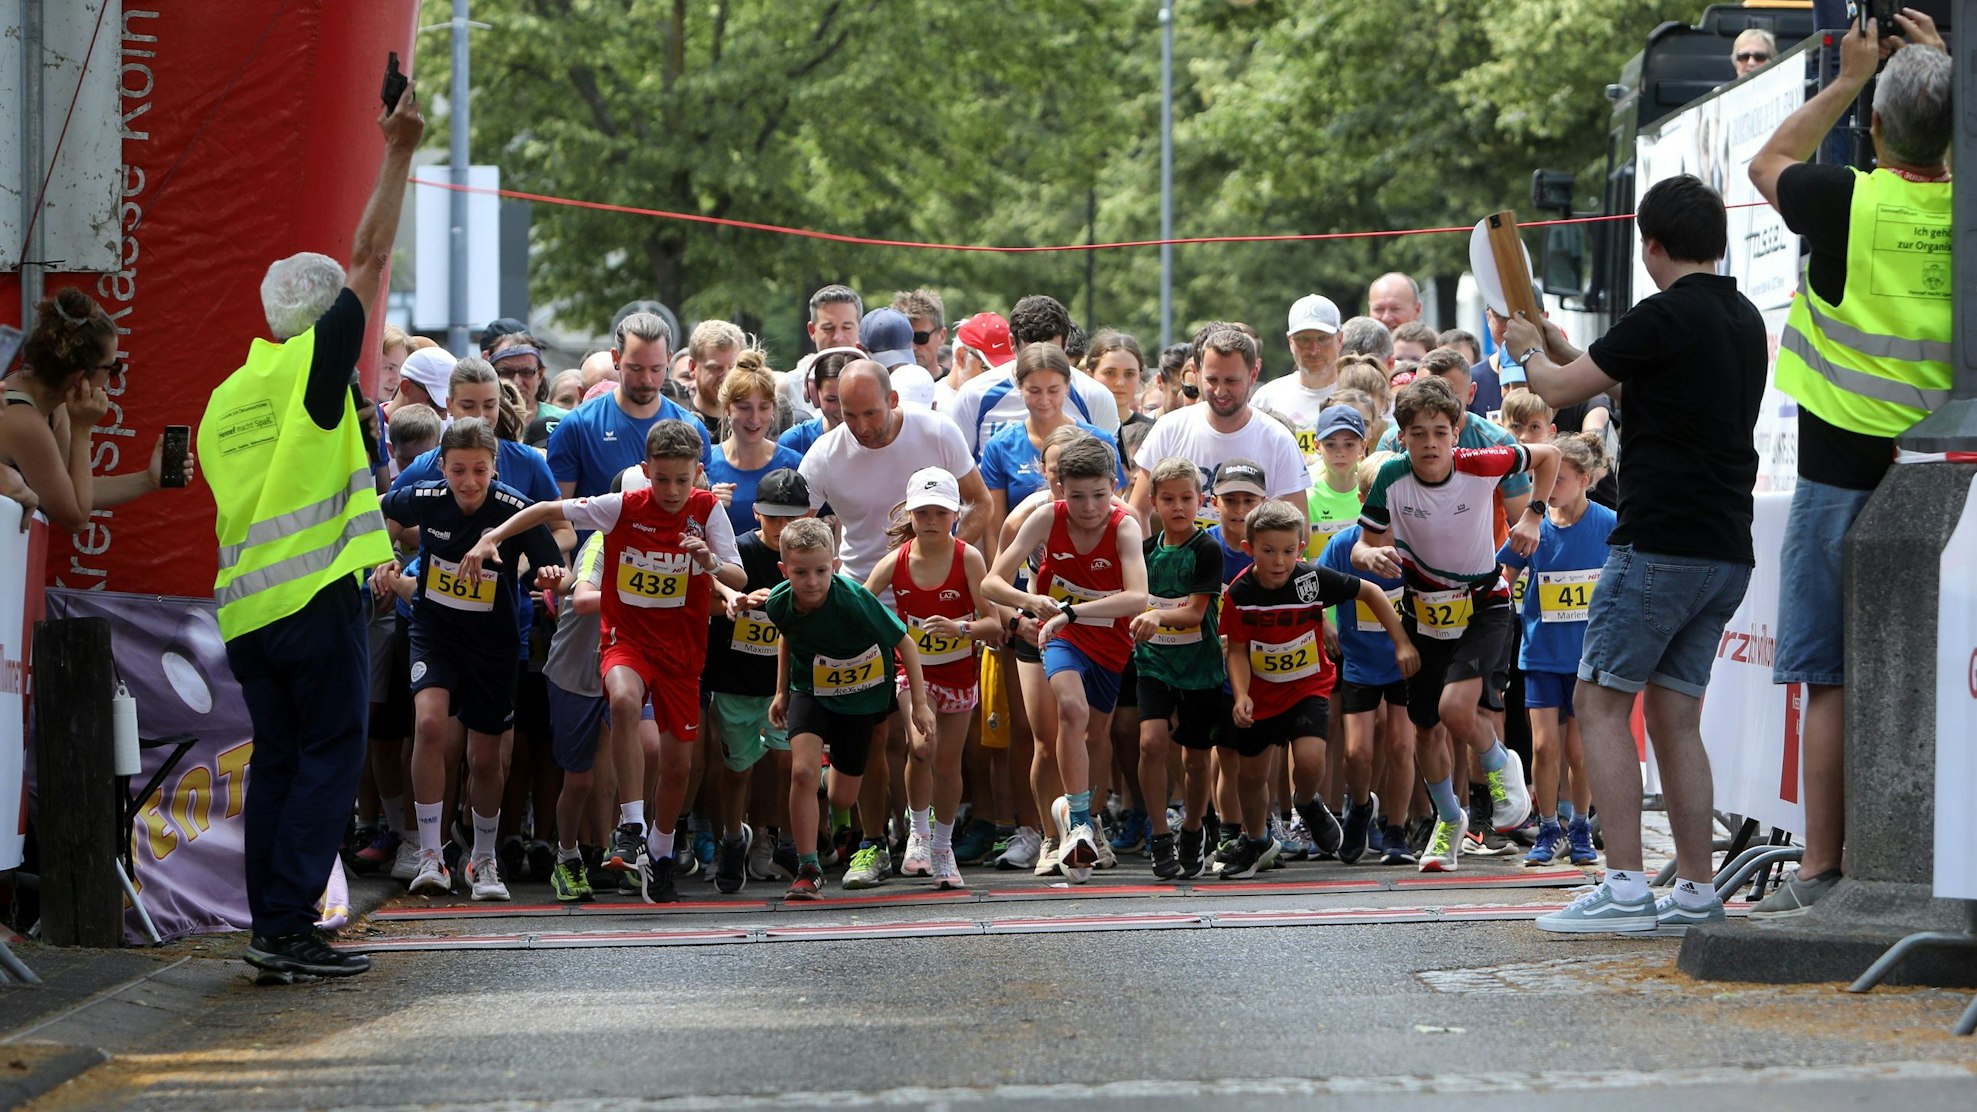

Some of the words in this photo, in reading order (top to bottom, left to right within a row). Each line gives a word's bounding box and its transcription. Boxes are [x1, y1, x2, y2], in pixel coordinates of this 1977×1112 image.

[1914, 227, 1928, 236] Ich
[1897, 241, 1913, 249] zur
[438, 573, 481, 599] 561
[629, 571, 677, 596] 438
[1558, 585, 1588, 607] 41
[1425, 605, 1455, 626] 32
[747, 623, 781, 644] 30
[1158, 635, 1176, 644] Nico
[1433, 630, 1450, 638] Tim
[1264, 649, 1308, 672] 582
[826, 663, 872, 686] 437
